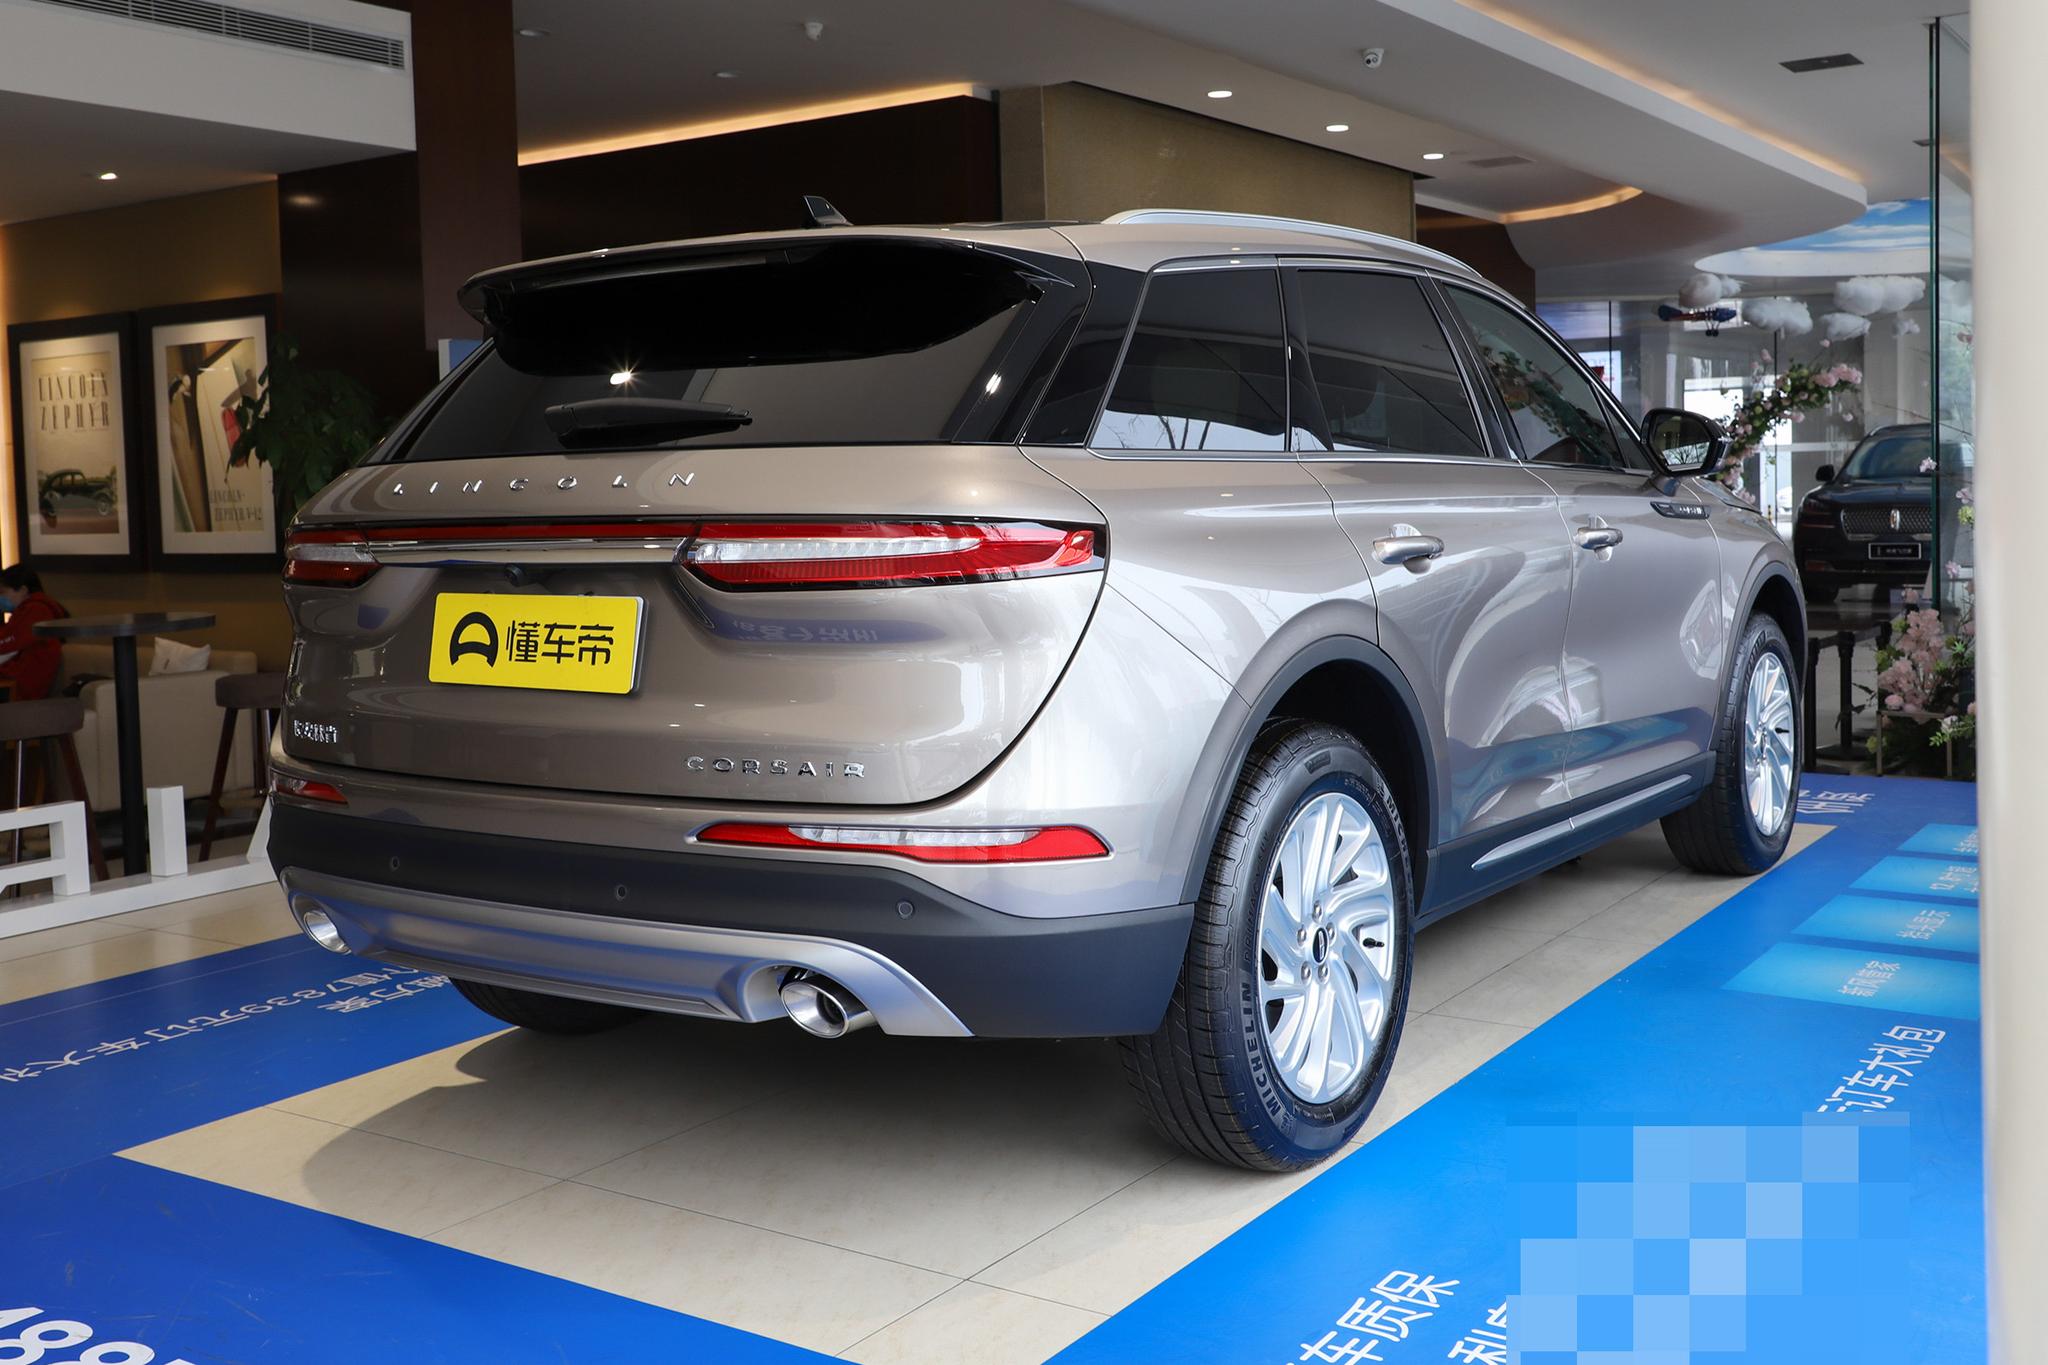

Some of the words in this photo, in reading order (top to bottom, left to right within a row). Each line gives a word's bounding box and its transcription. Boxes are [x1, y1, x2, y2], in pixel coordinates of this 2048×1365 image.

[38, 371, 109, 402] LINCOLN
[41, 401, 110, 431] ZEPHYR
[393, 471, 696, 496] LINCOLN
[505, 620, 614, 666] 懂车帝
[687, 756, 865, 778] CORSAIR
[1241, 981, 1282, 1118] MICHELIN
[1284, 1270, 1460, 1365] 车质保
